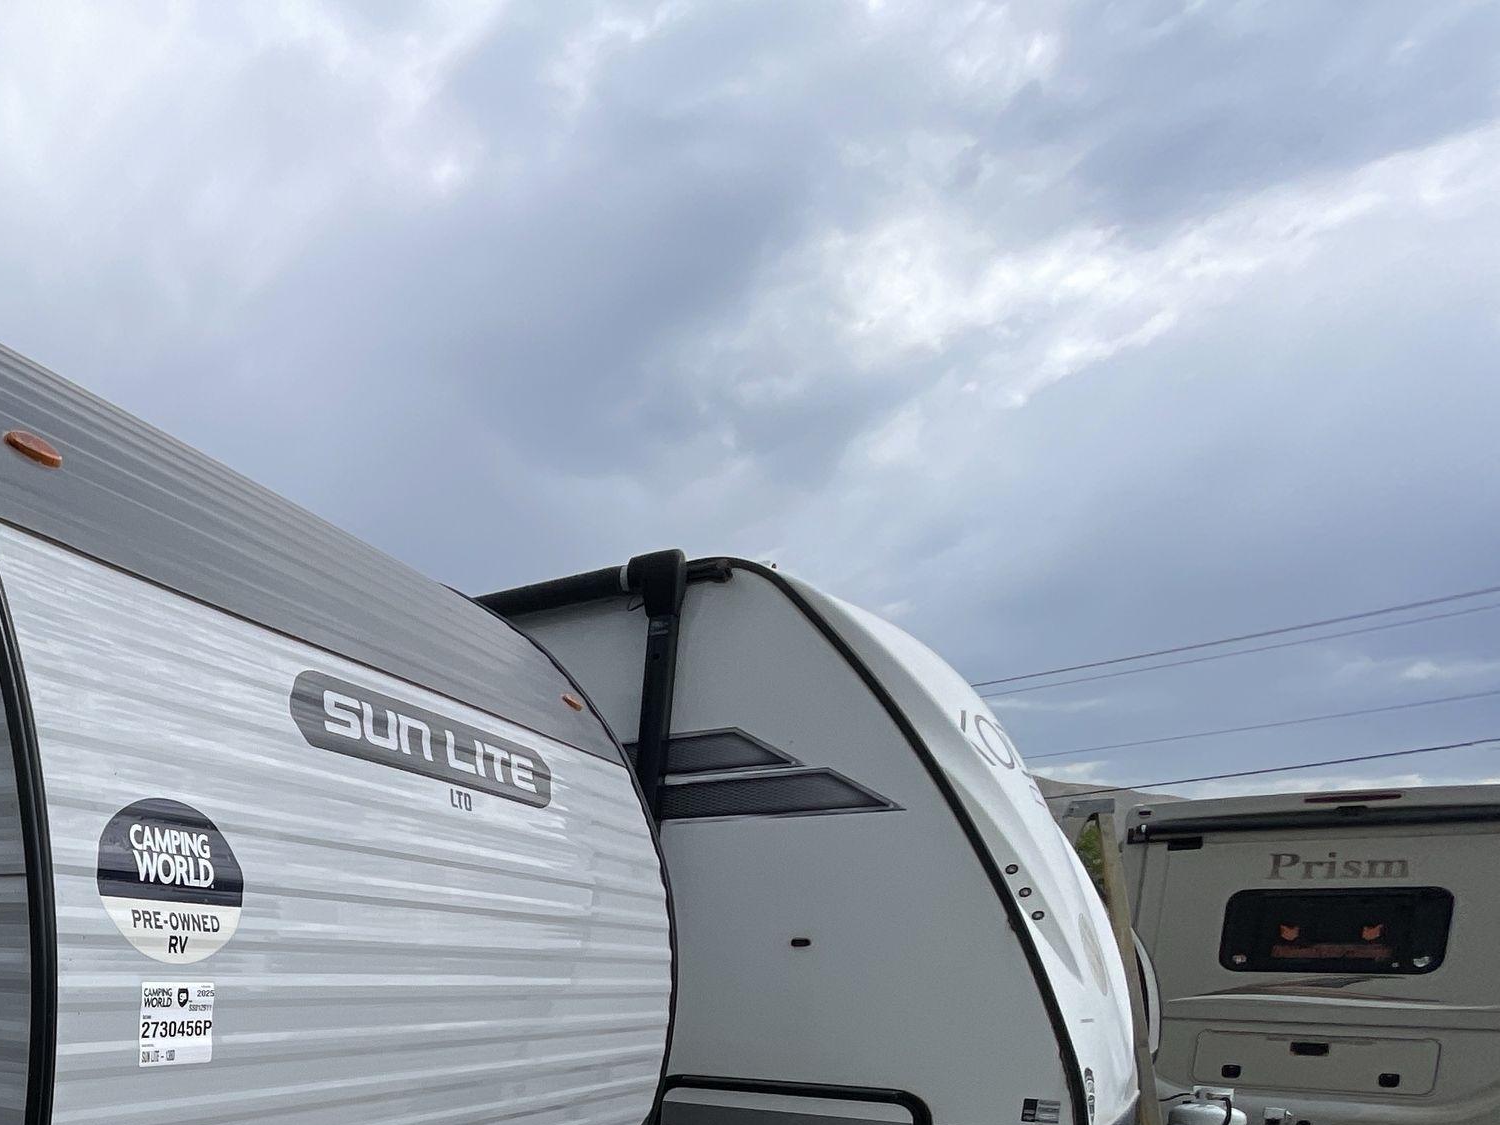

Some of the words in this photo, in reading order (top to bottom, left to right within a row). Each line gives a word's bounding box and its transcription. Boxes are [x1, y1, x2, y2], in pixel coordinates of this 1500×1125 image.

[323, 689, 434, 762] SUN
[444, 729, 537, 794] LITE
[450, 788, 473, 812] LTD
[129, 823, 211, 859] CAMPING
[132, 849, 215, 889] WORLD
[1266, 851, 1410, 881] Prism
[131, 909, 220, 933] PRE-OWNED
[168, 935, 189, 954] RV
[143, 987, 173, 998] CAMPING
[143, 997, 173, 1008] WORLD
[196, 989, 215, 998] 2025
[141, 1020, 213, 1039] 2730456P
